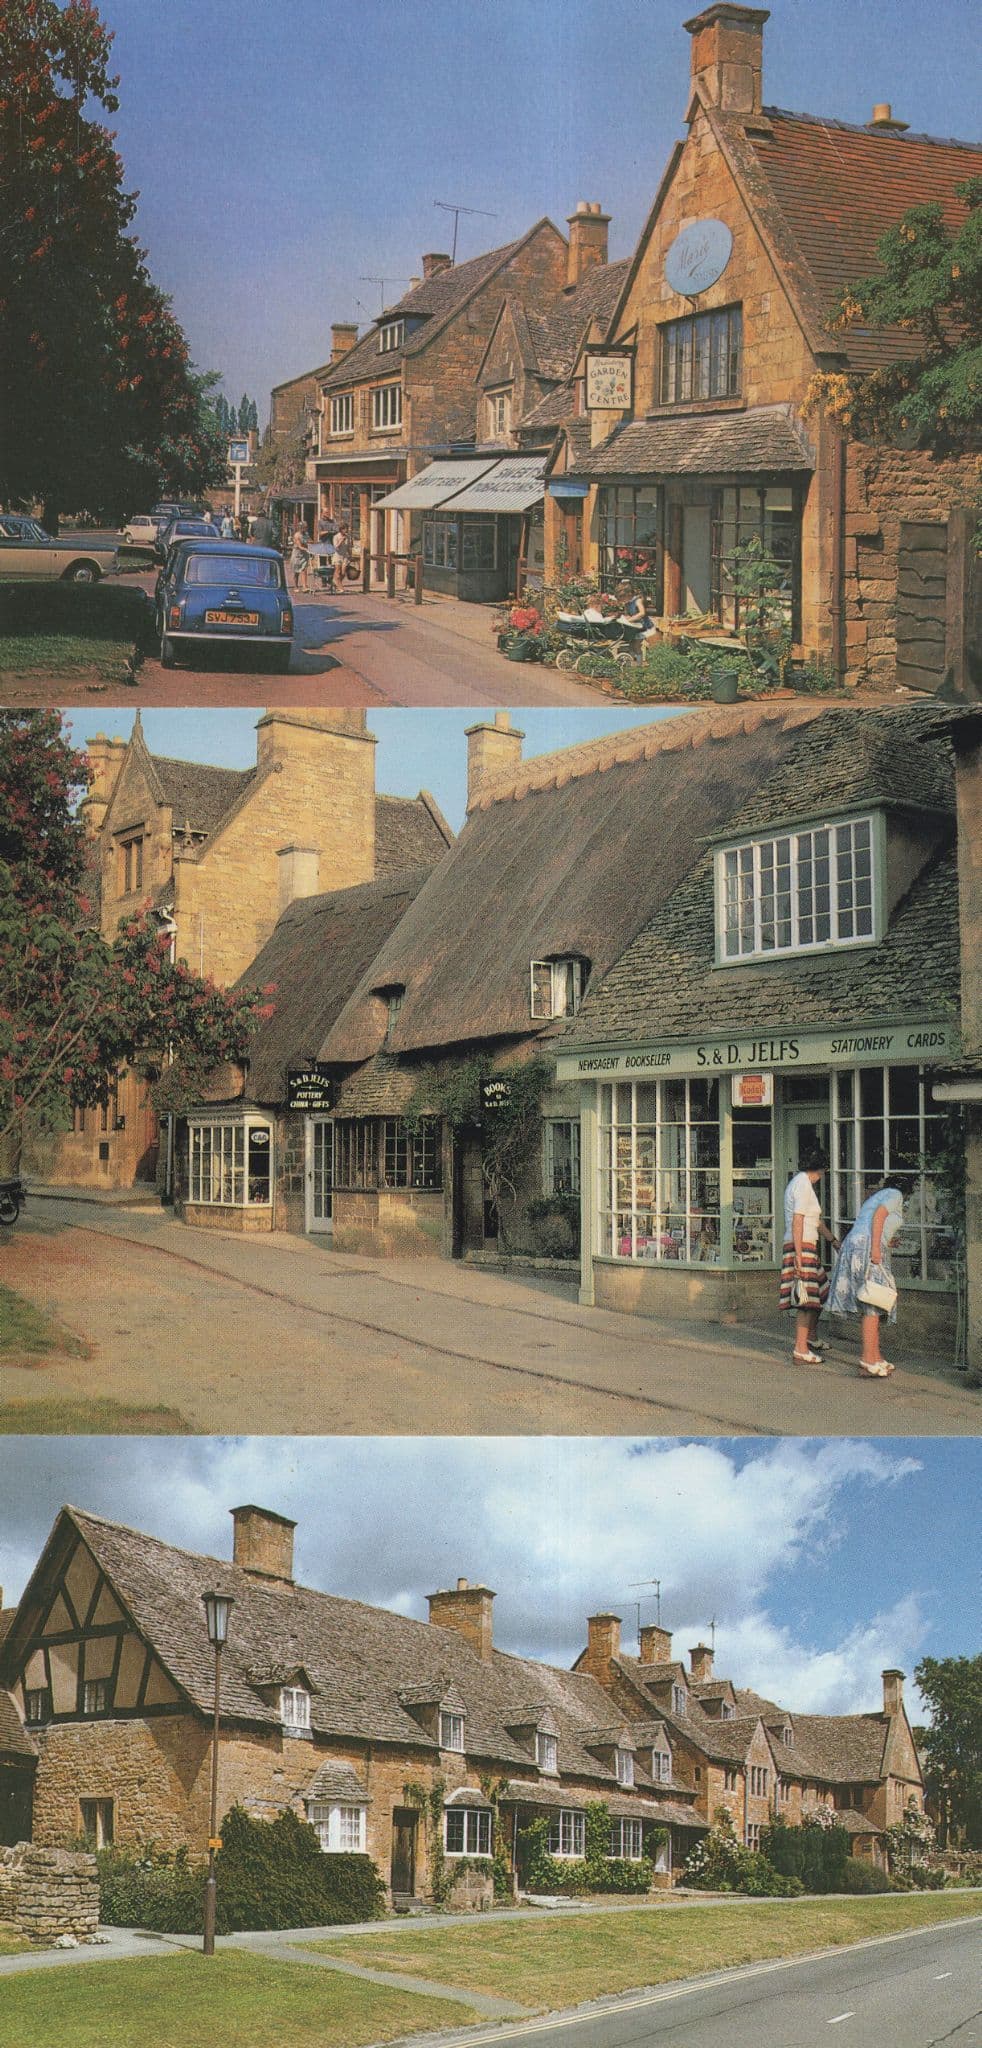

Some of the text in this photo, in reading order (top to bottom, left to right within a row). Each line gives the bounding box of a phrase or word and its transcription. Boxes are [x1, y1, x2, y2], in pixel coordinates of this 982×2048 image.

[590, 367, 628, 379] GARDEN
[590, 393, 630, 405] CENTRE
[578, 1057, 620, 1071] NEWSAGENT
[625, 1053, 671, 1068] BOOKSELLER
[747, 1039, 800, 1063] JELFS
[830, 1035, 894, 1053] STATIONERY
[906, 1032, 946, 1048] CARDS
[483, 1082, 512, 1097] BOOKS
